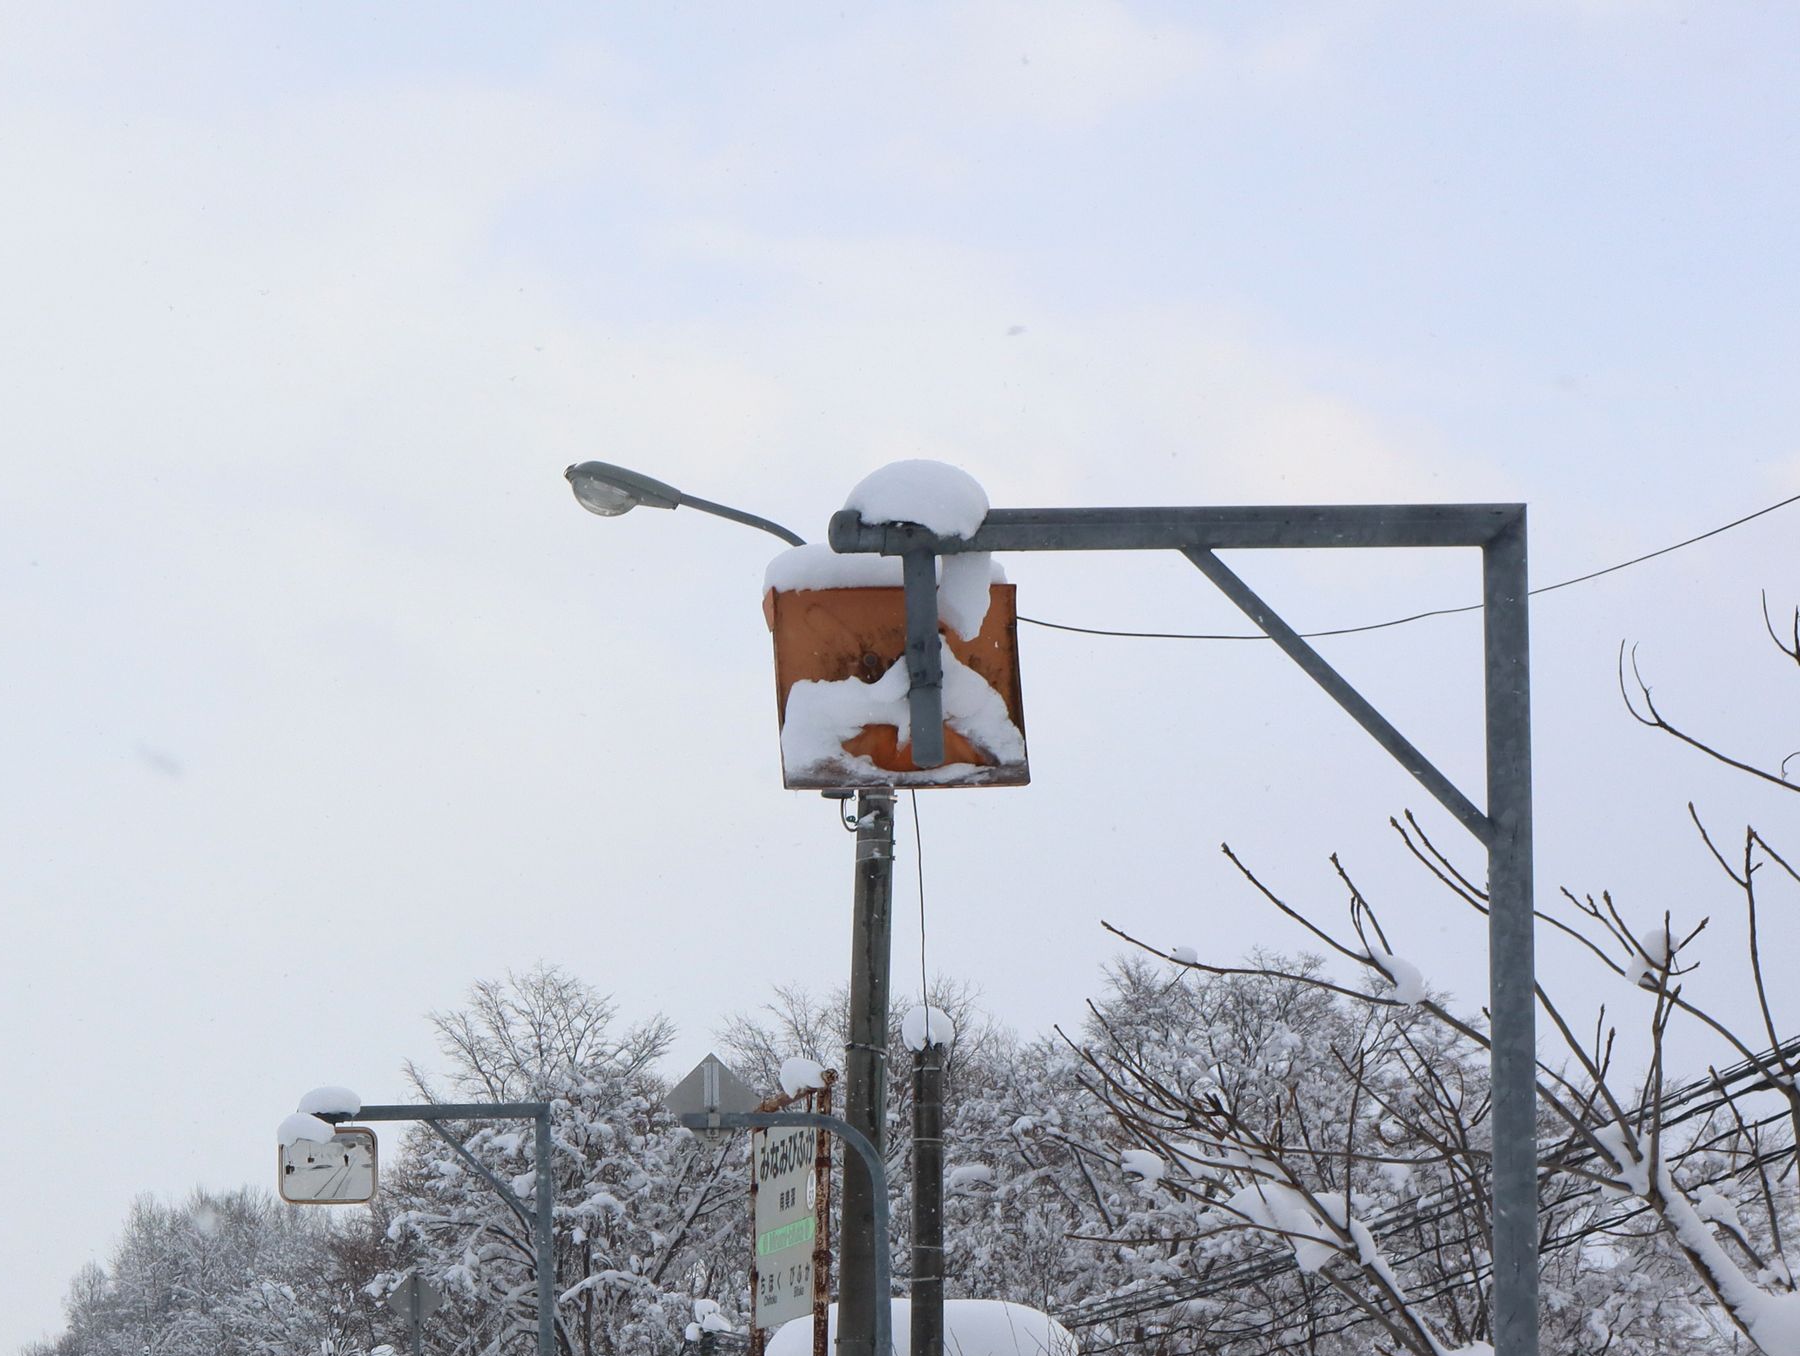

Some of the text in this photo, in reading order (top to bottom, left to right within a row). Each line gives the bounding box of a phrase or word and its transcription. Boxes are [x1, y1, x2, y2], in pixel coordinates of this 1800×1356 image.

[760, 1129, 815, 1181] みなみびふか
